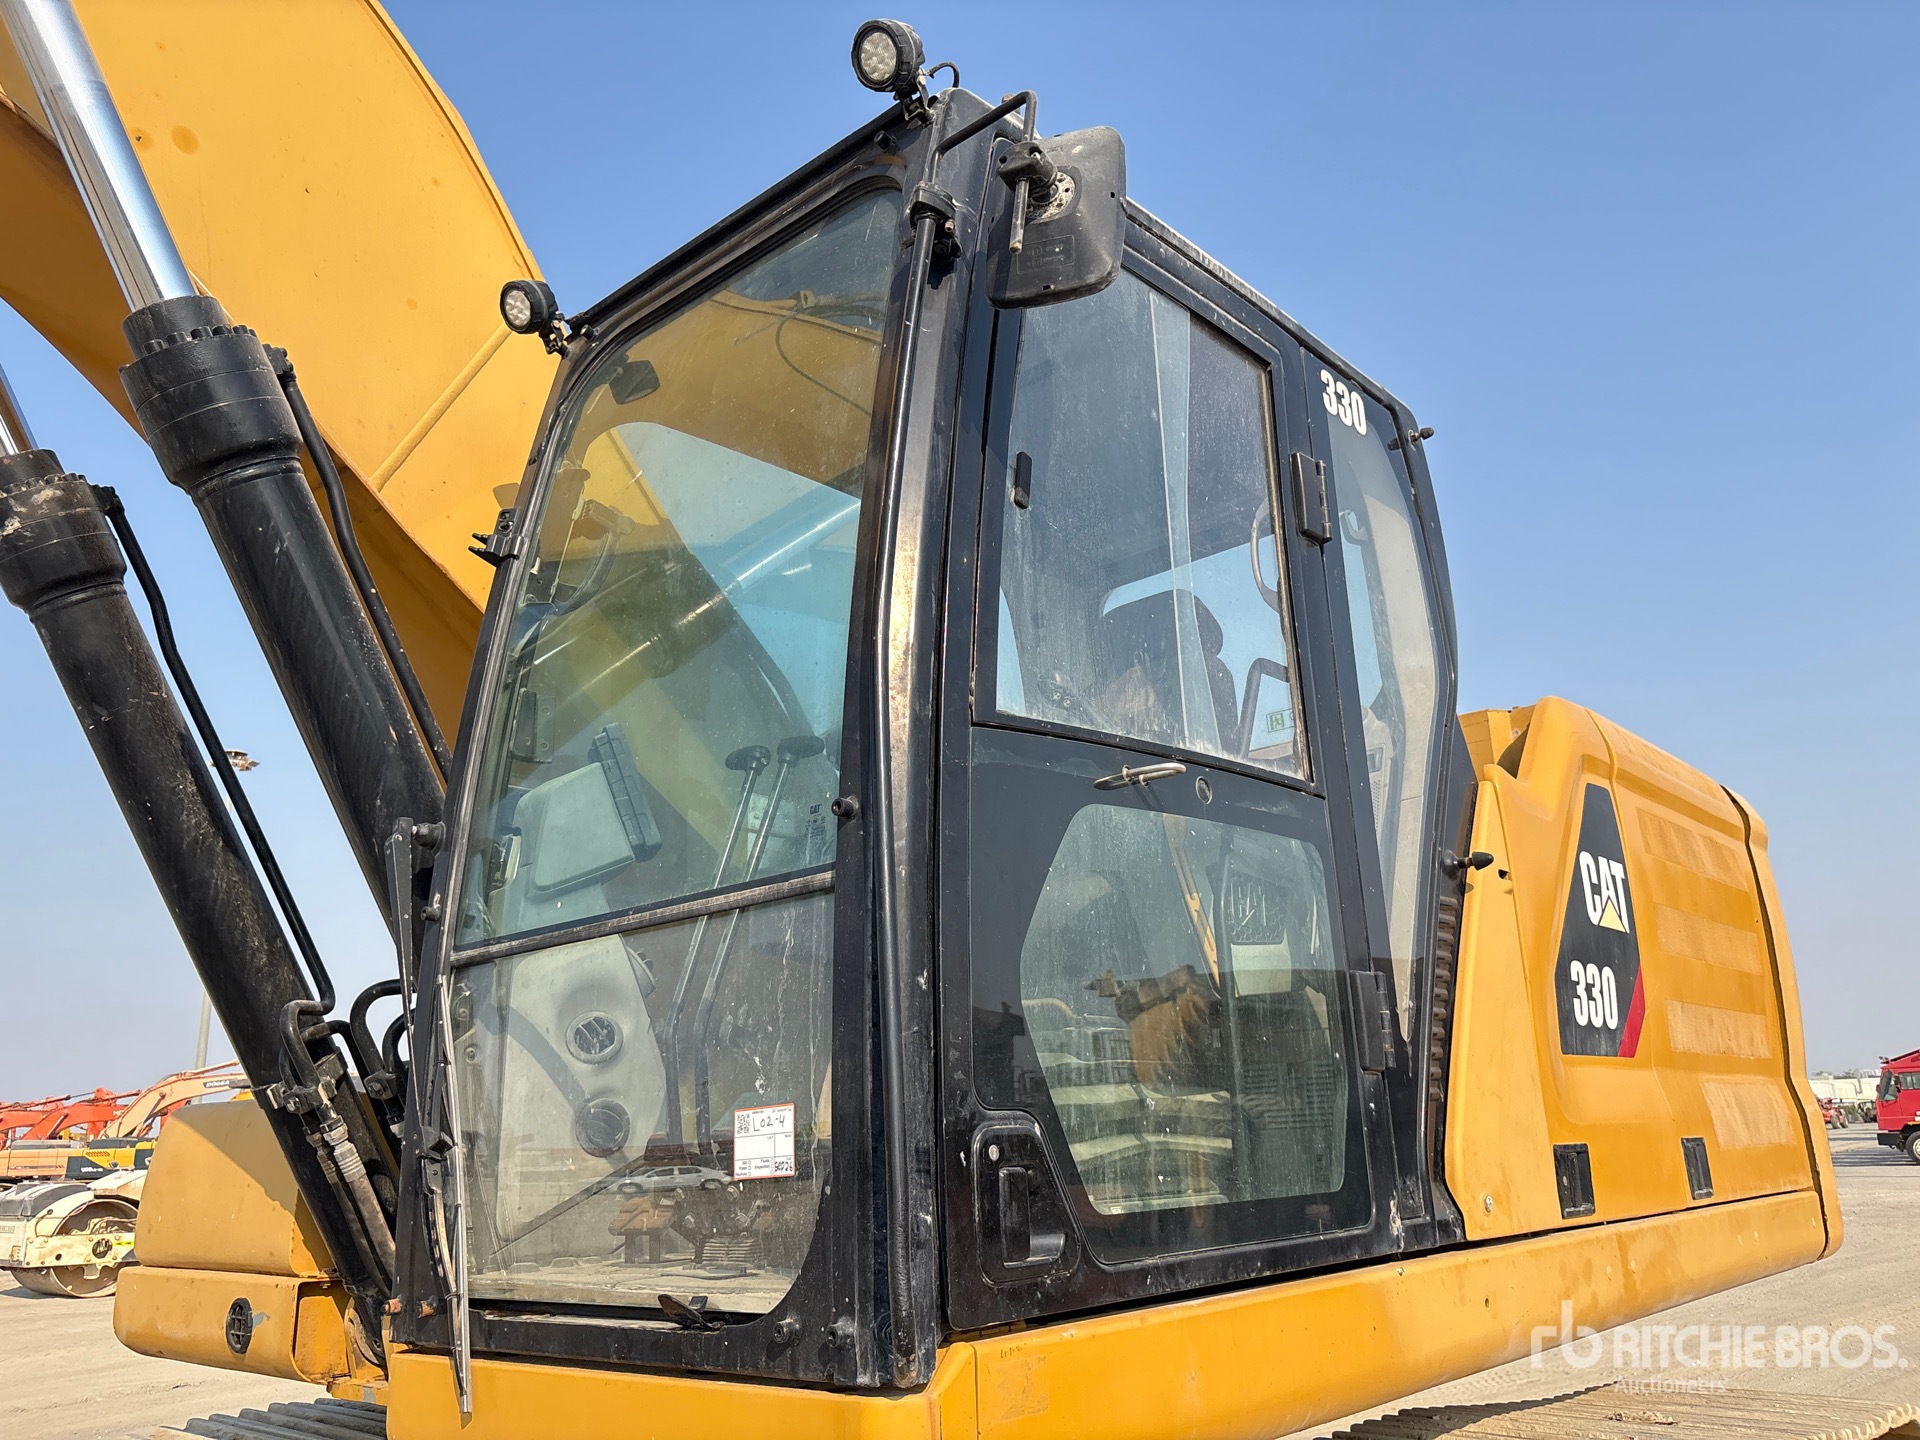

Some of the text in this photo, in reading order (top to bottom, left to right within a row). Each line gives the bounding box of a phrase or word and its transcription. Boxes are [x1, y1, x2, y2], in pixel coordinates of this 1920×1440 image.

[1320, 369, 1367, 435] 330
[1579, 850, 1630, 934] CAT
[1570, 960, 1619, 1030] 330
